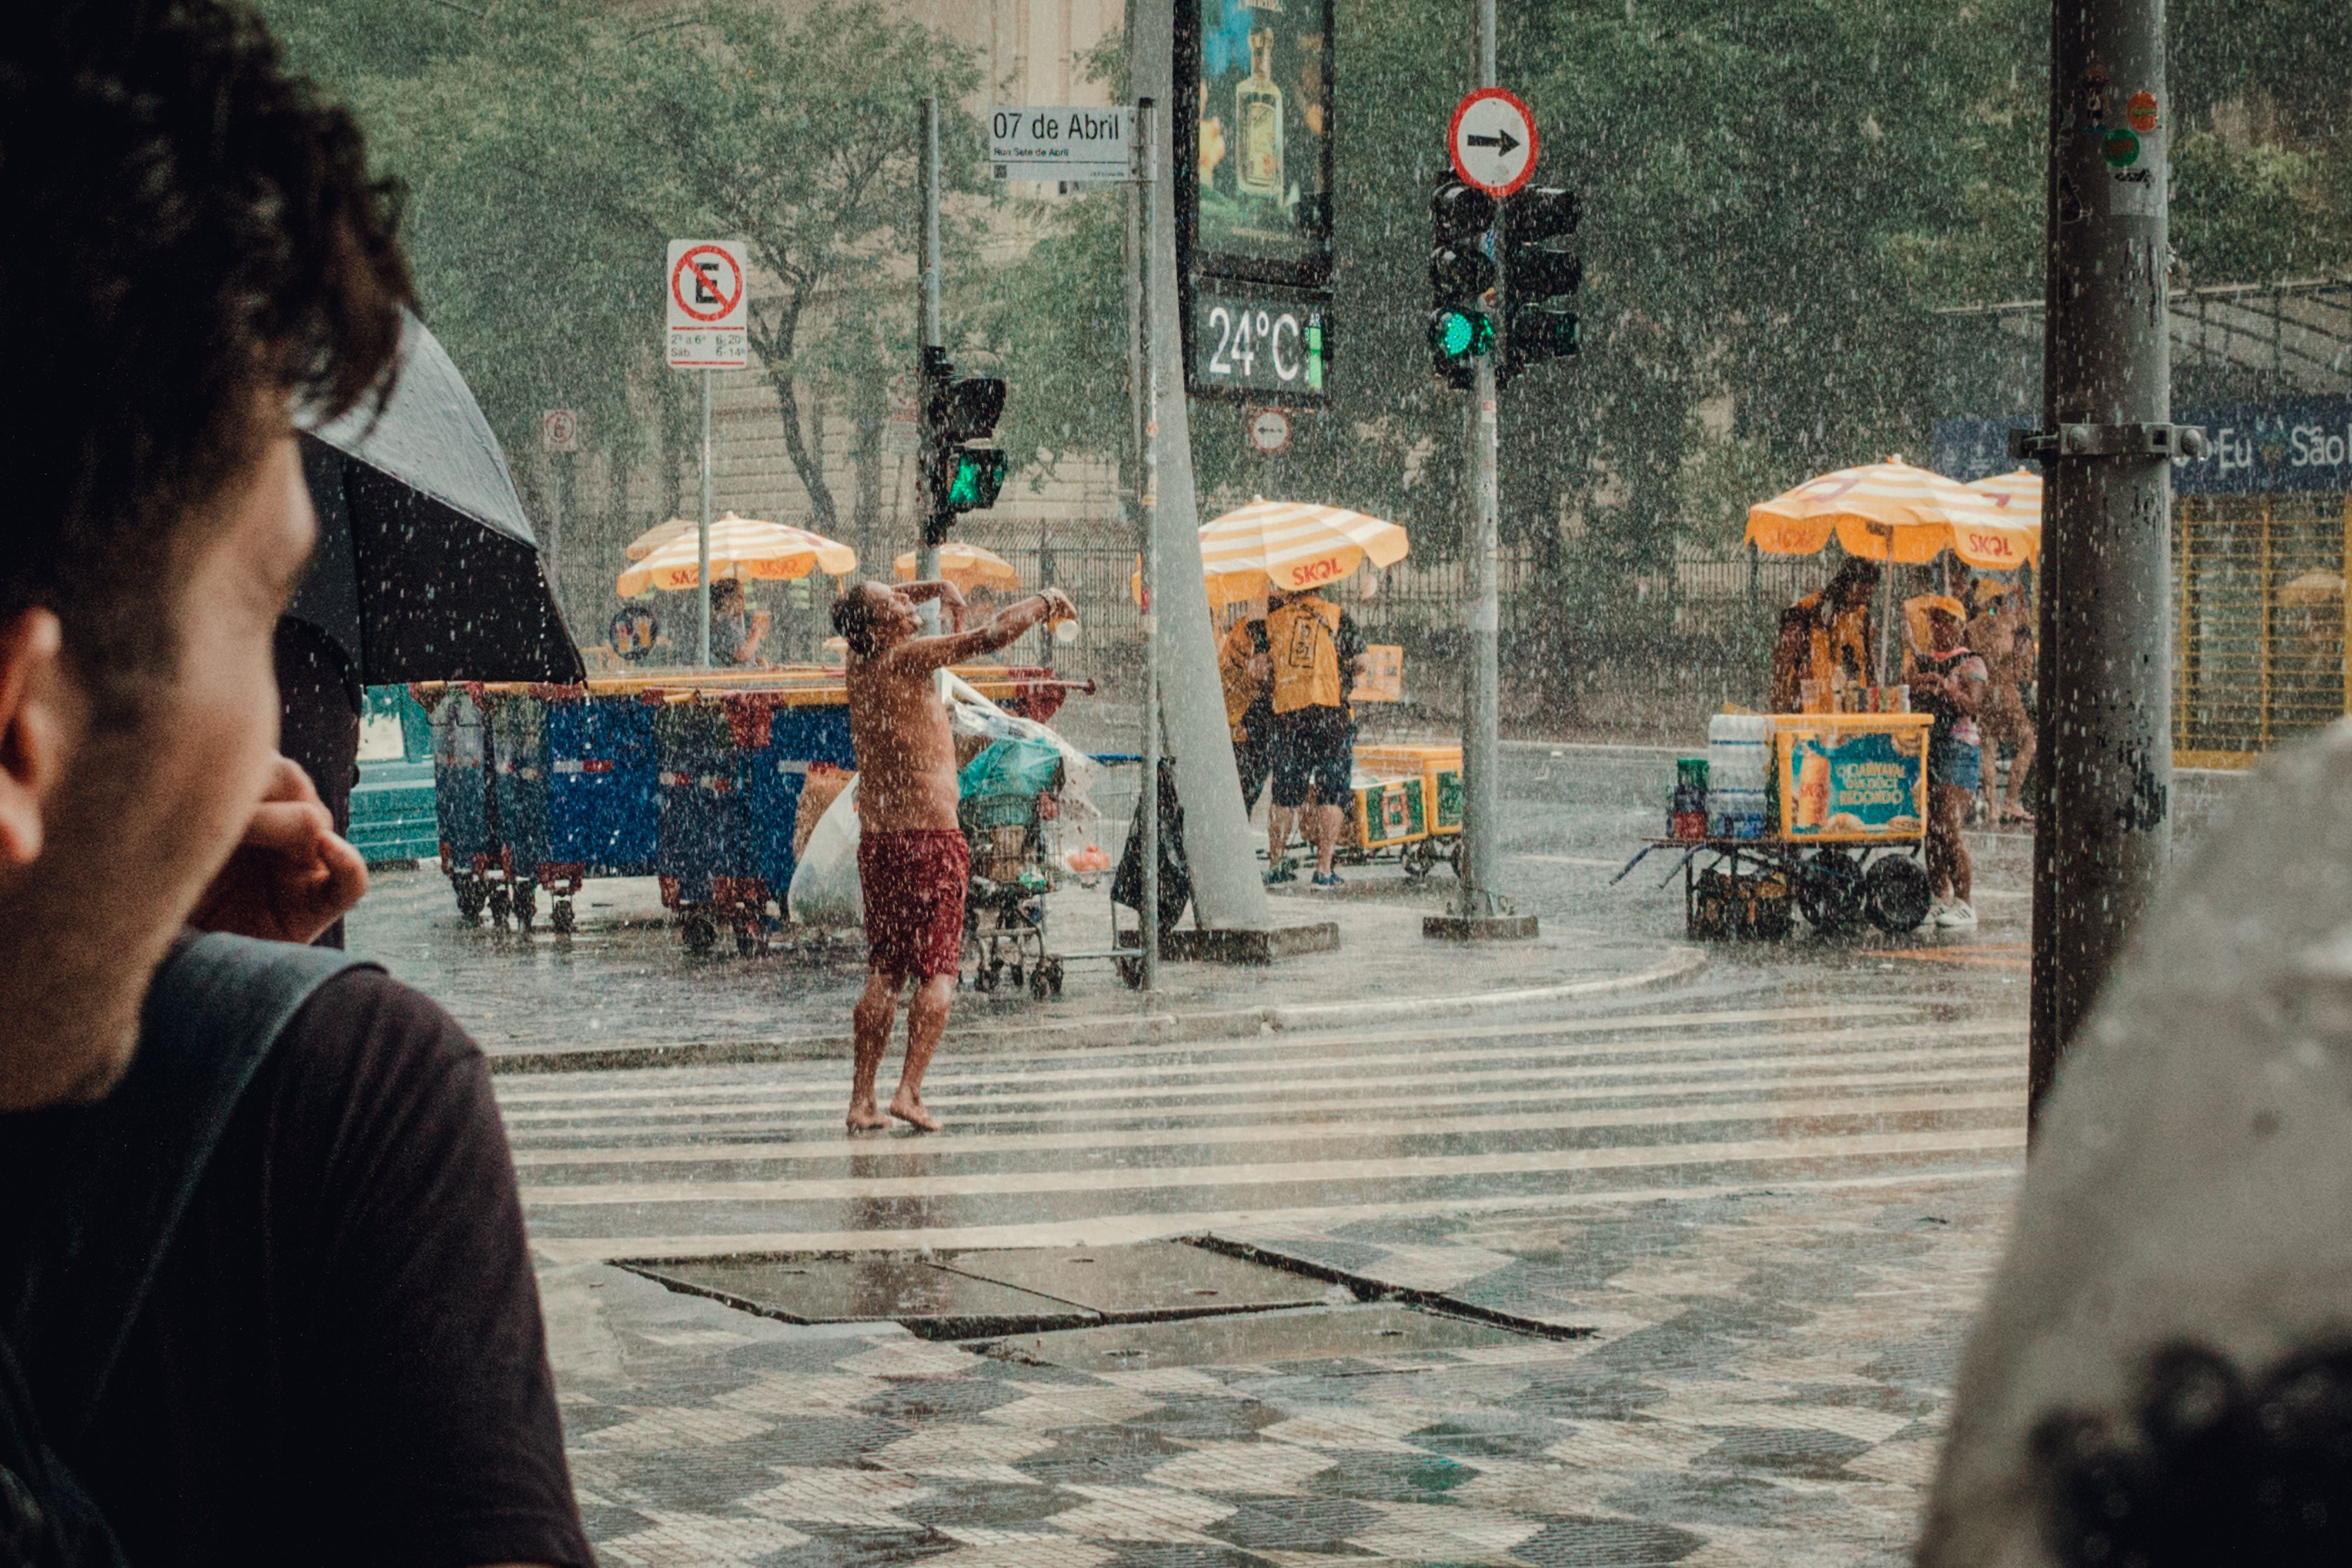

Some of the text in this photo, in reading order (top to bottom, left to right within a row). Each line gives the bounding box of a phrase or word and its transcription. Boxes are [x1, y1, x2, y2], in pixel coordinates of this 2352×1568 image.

[994, 112, 1119, 140] 07 de Abril
[994, 148, 1069, 157] Rua Sete de Abril
[696, 263, 719, 304] E
[1208, 307, 1299, 381] 24°C
[2219, 428, 2252, 469] Eu
[2291, 424, 2345, 467] São
[1968, 533, 2013, 557] SKOL
[1291, 557, 1343, 586] SKOL
